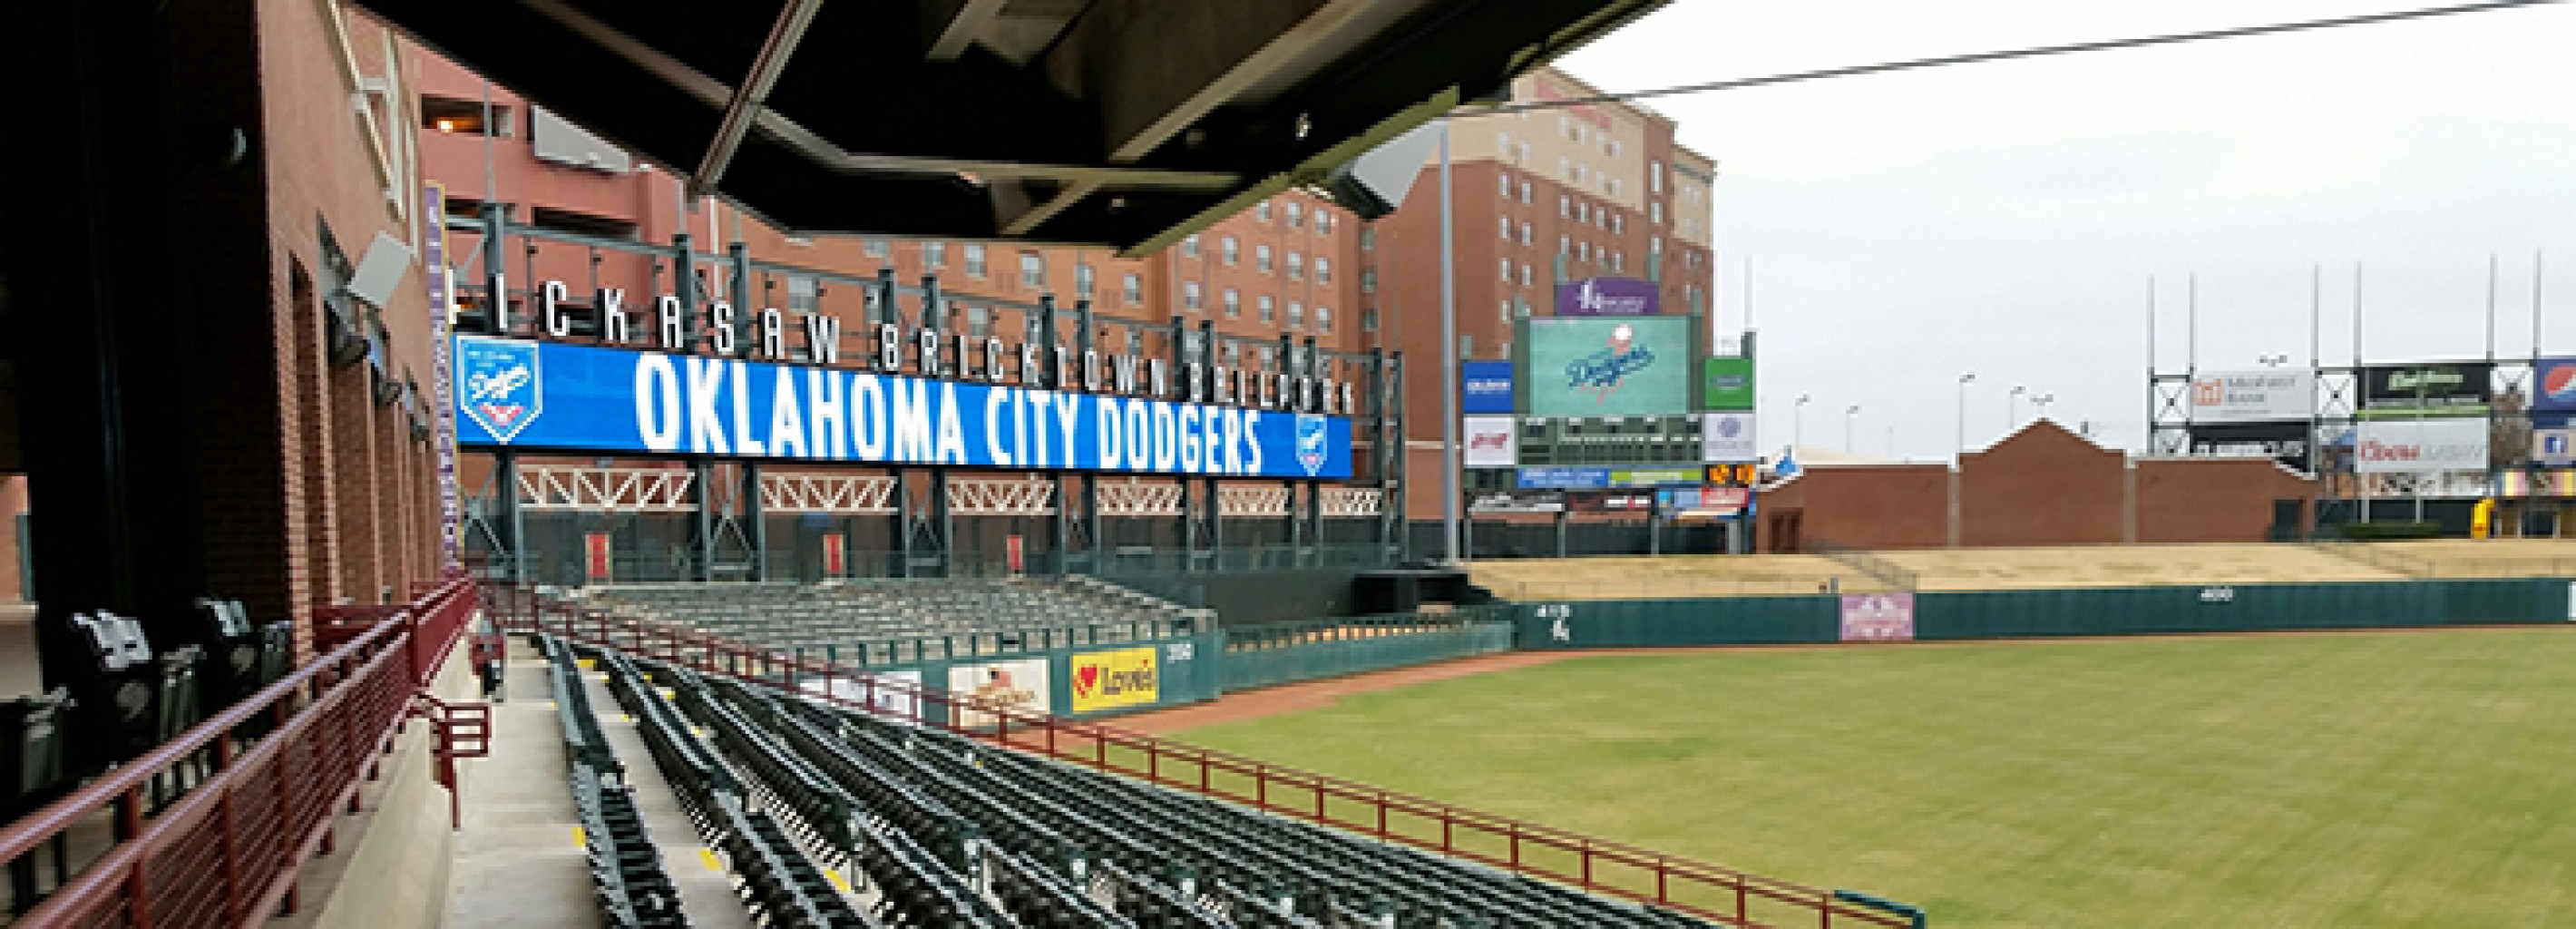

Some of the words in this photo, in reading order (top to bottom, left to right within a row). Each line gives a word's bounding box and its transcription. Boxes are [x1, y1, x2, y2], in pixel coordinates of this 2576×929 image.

[633, 355, 965, 465] OKLAHOMA
[985, 386, 1080, 469] CITY
[1098, 397, 1263, 474] DODGERS
